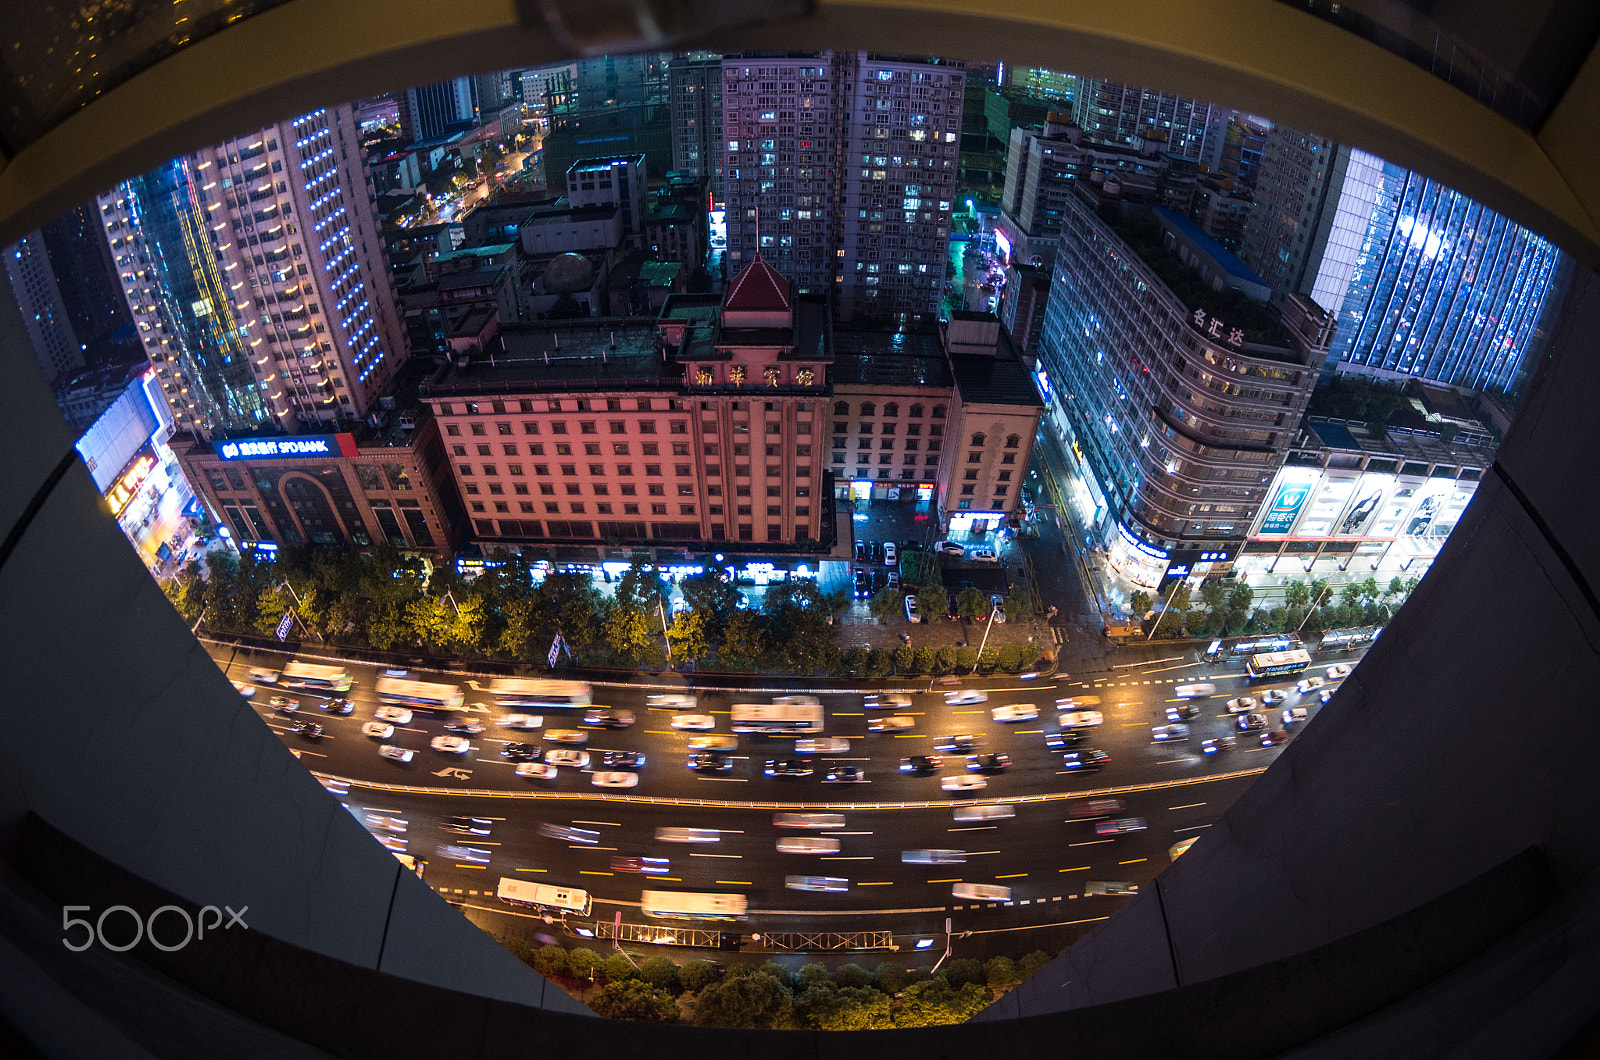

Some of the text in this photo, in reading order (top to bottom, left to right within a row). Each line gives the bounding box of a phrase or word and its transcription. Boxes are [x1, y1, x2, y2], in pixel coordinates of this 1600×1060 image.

[1193, 308, 1245, 347] 名汇达
[278, 441, 298, 453] SPD
[297, 440, 328, 453] BANK
[1267, 513, 1296, 522] 屈臣氏
